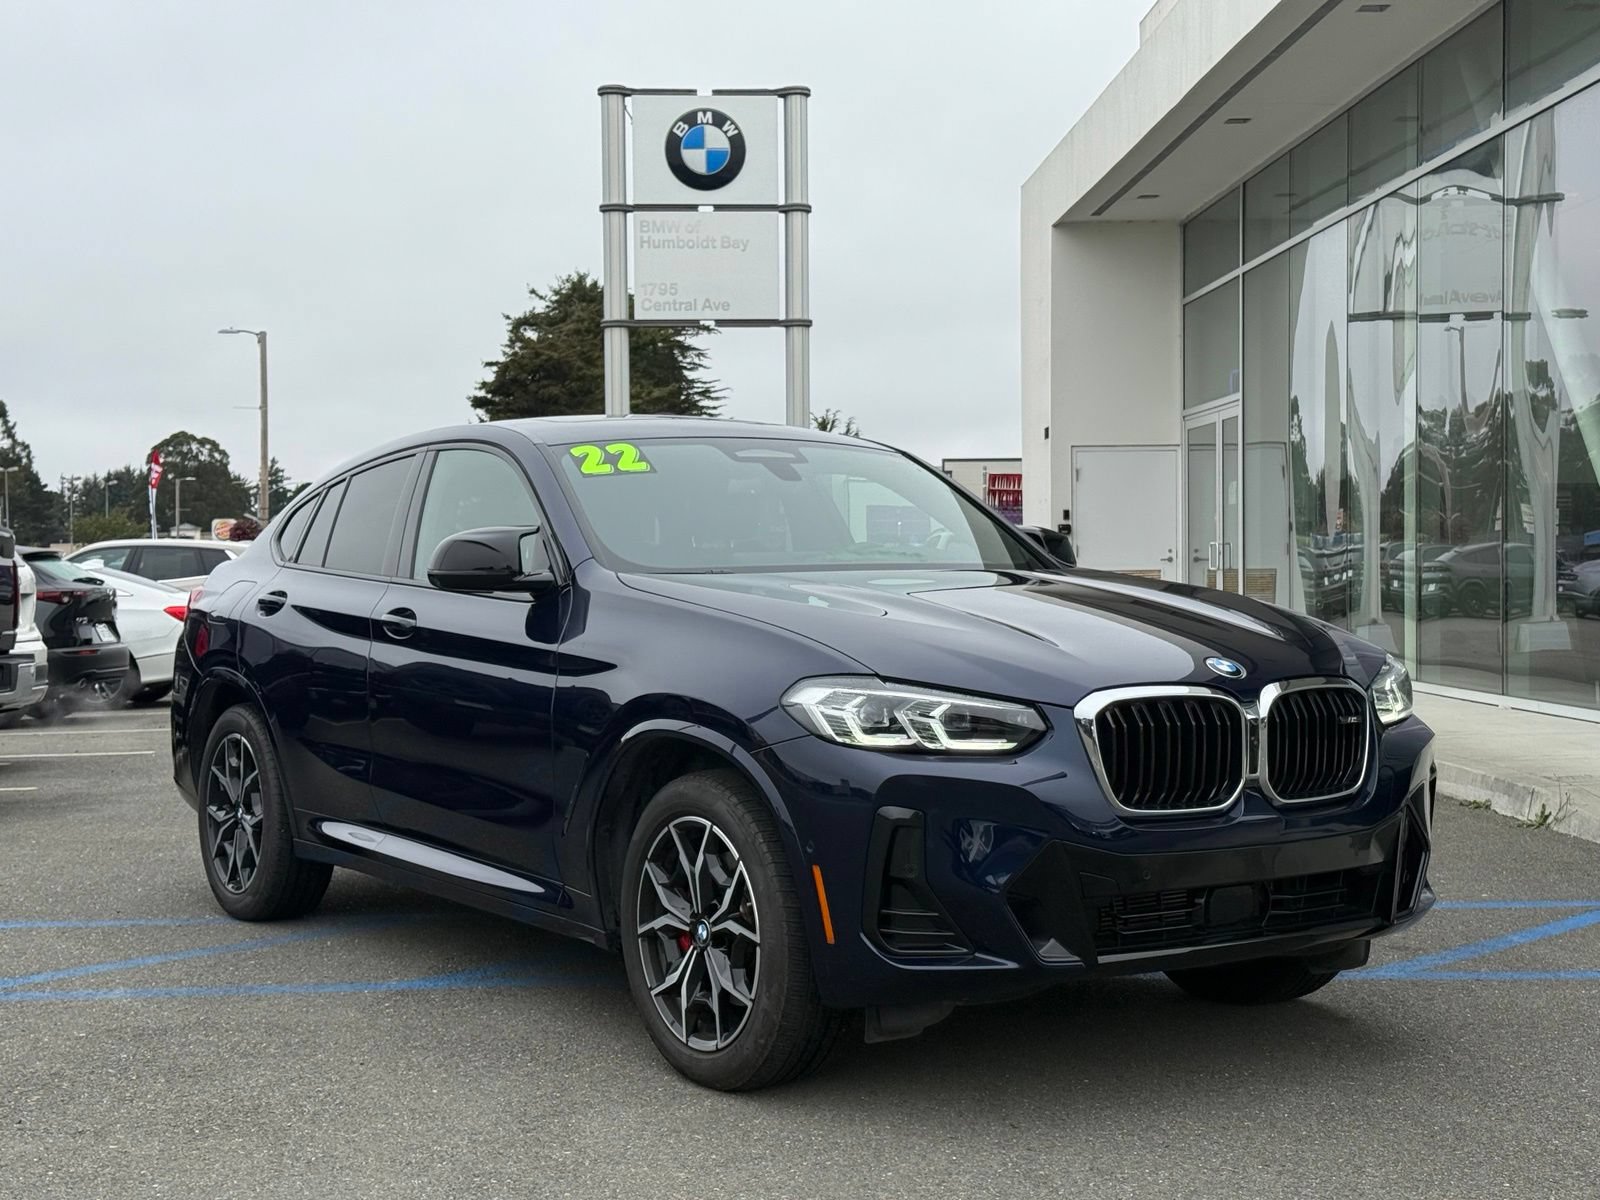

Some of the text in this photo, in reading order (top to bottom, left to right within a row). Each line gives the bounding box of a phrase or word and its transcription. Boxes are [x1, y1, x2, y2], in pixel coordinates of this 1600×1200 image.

[672, 111, 739, 138] BMW
[639, 219, 681, 234] BMW
[639, 235, 750, 253] Humboldt Bay
[641, 282, 679, 297] 1795
[641, 297, 731, 312] Central Ave
[570, 443, 650, 475] 22
